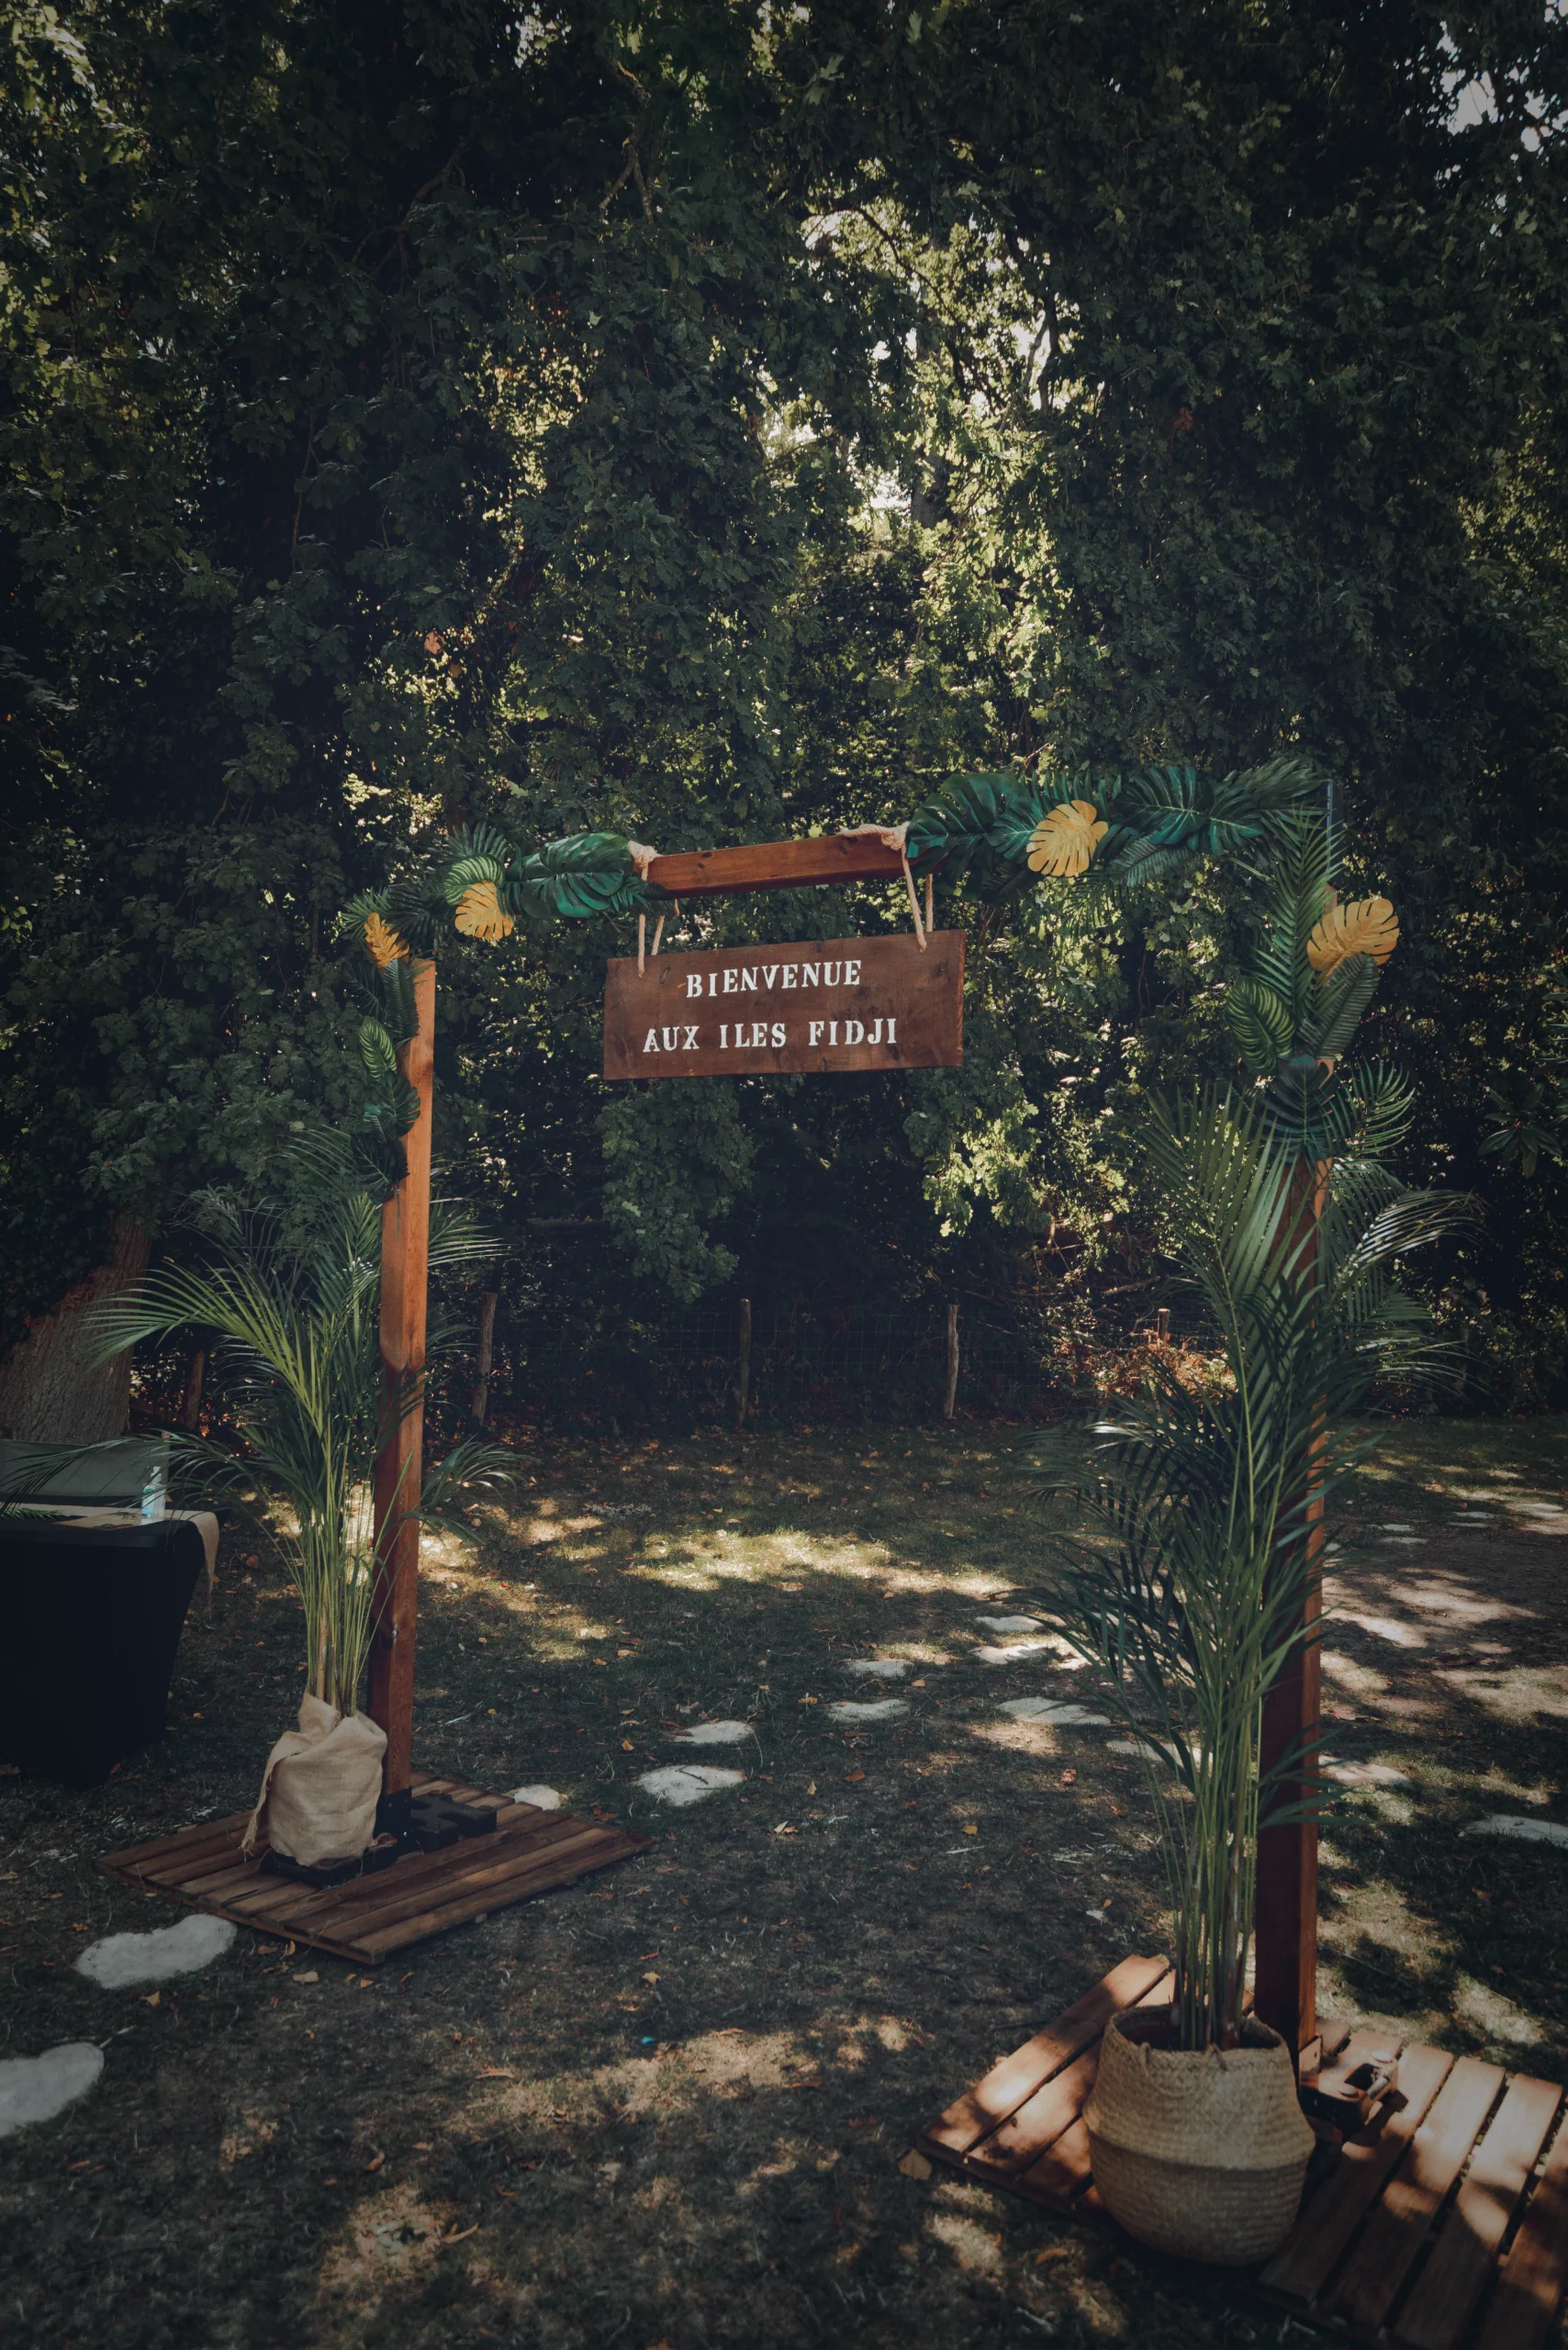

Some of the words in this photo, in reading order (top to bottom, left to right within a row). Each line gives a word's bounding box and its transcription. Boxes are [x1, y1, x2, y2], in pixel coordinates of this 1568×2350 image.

[686, 959, 862, 999] BIENVENUE
[642, 1024, 700, 1053] AUX
[719, 1022, 787, 1049] ILES
[808, 1018, 898, 1046] FIDJI
